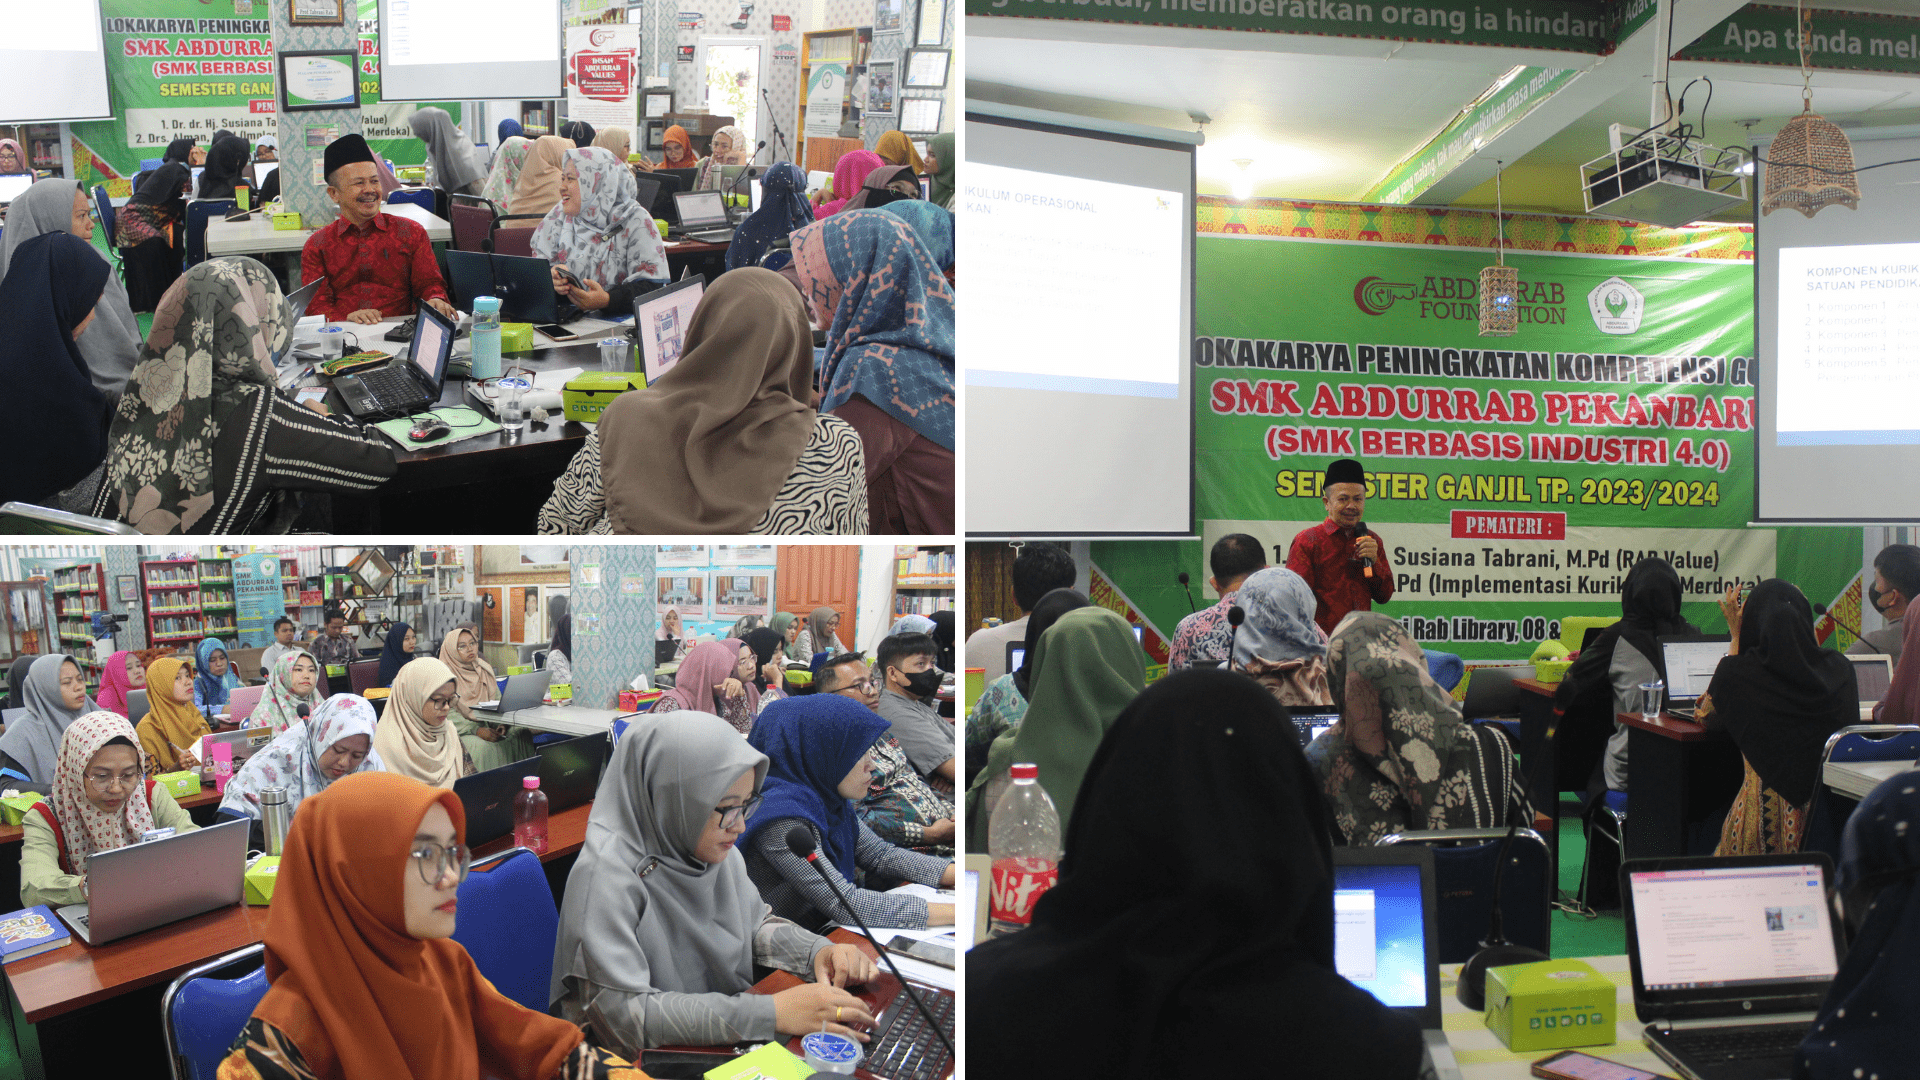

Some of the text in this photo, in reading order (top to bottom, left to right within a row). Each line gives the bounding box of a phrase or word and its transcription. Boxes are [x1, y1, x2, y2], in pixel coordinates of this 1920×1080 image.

[107, 18, 196, 34] LOKAKARYA
[1382, 5, 1466, 35] orang
[1475, 6, 1498, 31] ia
[1506, 7, 1606, 38] hindari
[124, 39, 171, 56] SMK
[1723, 22, 1777, 53] Apa
[1869, 34, 1920, 59] mel
[154, 62, 197, 77] (SMK
[584, 64, 621, 73] ABDURRAB
[160, 83, 237, 97] SEMESTER
[1507, 83, 1528, 113] masa
[256, 101, 275, 112] PEM
[161, 121, 169, 130] 1.
[172, 120, 186, 129] Dr.
[189, 119, 203, 129] dr.
[206, 118, 219, 131] Hj.
[221, 117, 263, 129] Susiana
[367, 125, 410, 137] Merdeka)
[136, 134, 145, 144] 2.
[149, 133, 169, 143] Drs.
[965, 202, 992, 215] KAN
[1015, 192, 1098, 214] OPERASIONAL
[1807, 264, 1920, 277] KOMPONEN KURIK
[1419, 276, 1566, 305] ABDRAB
[1807, 281, 1856, 291] SATUAN
[1419, 301, 1567, 325] FOUNTION
[1818, 302, 1878, 312] Komponen
[1818, 316, 1878, 326] Komponen
[1818, 330, 1878, 340] Komponen
[1818, 344, 1878, 355] Komponen
[1357, 345, 1550, 381] PENINGKATAN
[1557, 354, 1724, 386] KOMPETENSI
[1818, 358, 1878, 369] Komponen
[1211, 380, 1754, 431] SMK ABDURRAB PEKANBAR
[1267, 427, 1730, 472] (SMK BERBASIS INDUSTRI 4.0)
[1276, 470, 1719, 511] SESTER GANJIL TP. 2023/2024
[1465, 516, 1543, 536] PEMATERI
[1273, 545, 1287, 564] 1.
[1394, 547, 1475, 566] Susiana
[1482, 548, 1561, 571] Tabrani,
[1566, 549, 1610, 568] M.Pd
[1664, 550, 1719, 572] Value)
[237, 579, 275, 587] ABDURRAB
[237, 585, 279, 593] PEKANBARU
[1394, 573, 1421, 593] .Pd
[1429, 572, 1571, 598] (Implementasi
[1578, 575, 1625, 594] Kurik
[1414, 618, 1449, 640] Rab
[1453, 618, 1519, 643] Library,
[1523, 618, 1546, 641] 08
[1549, 623, 1561, 641] &
